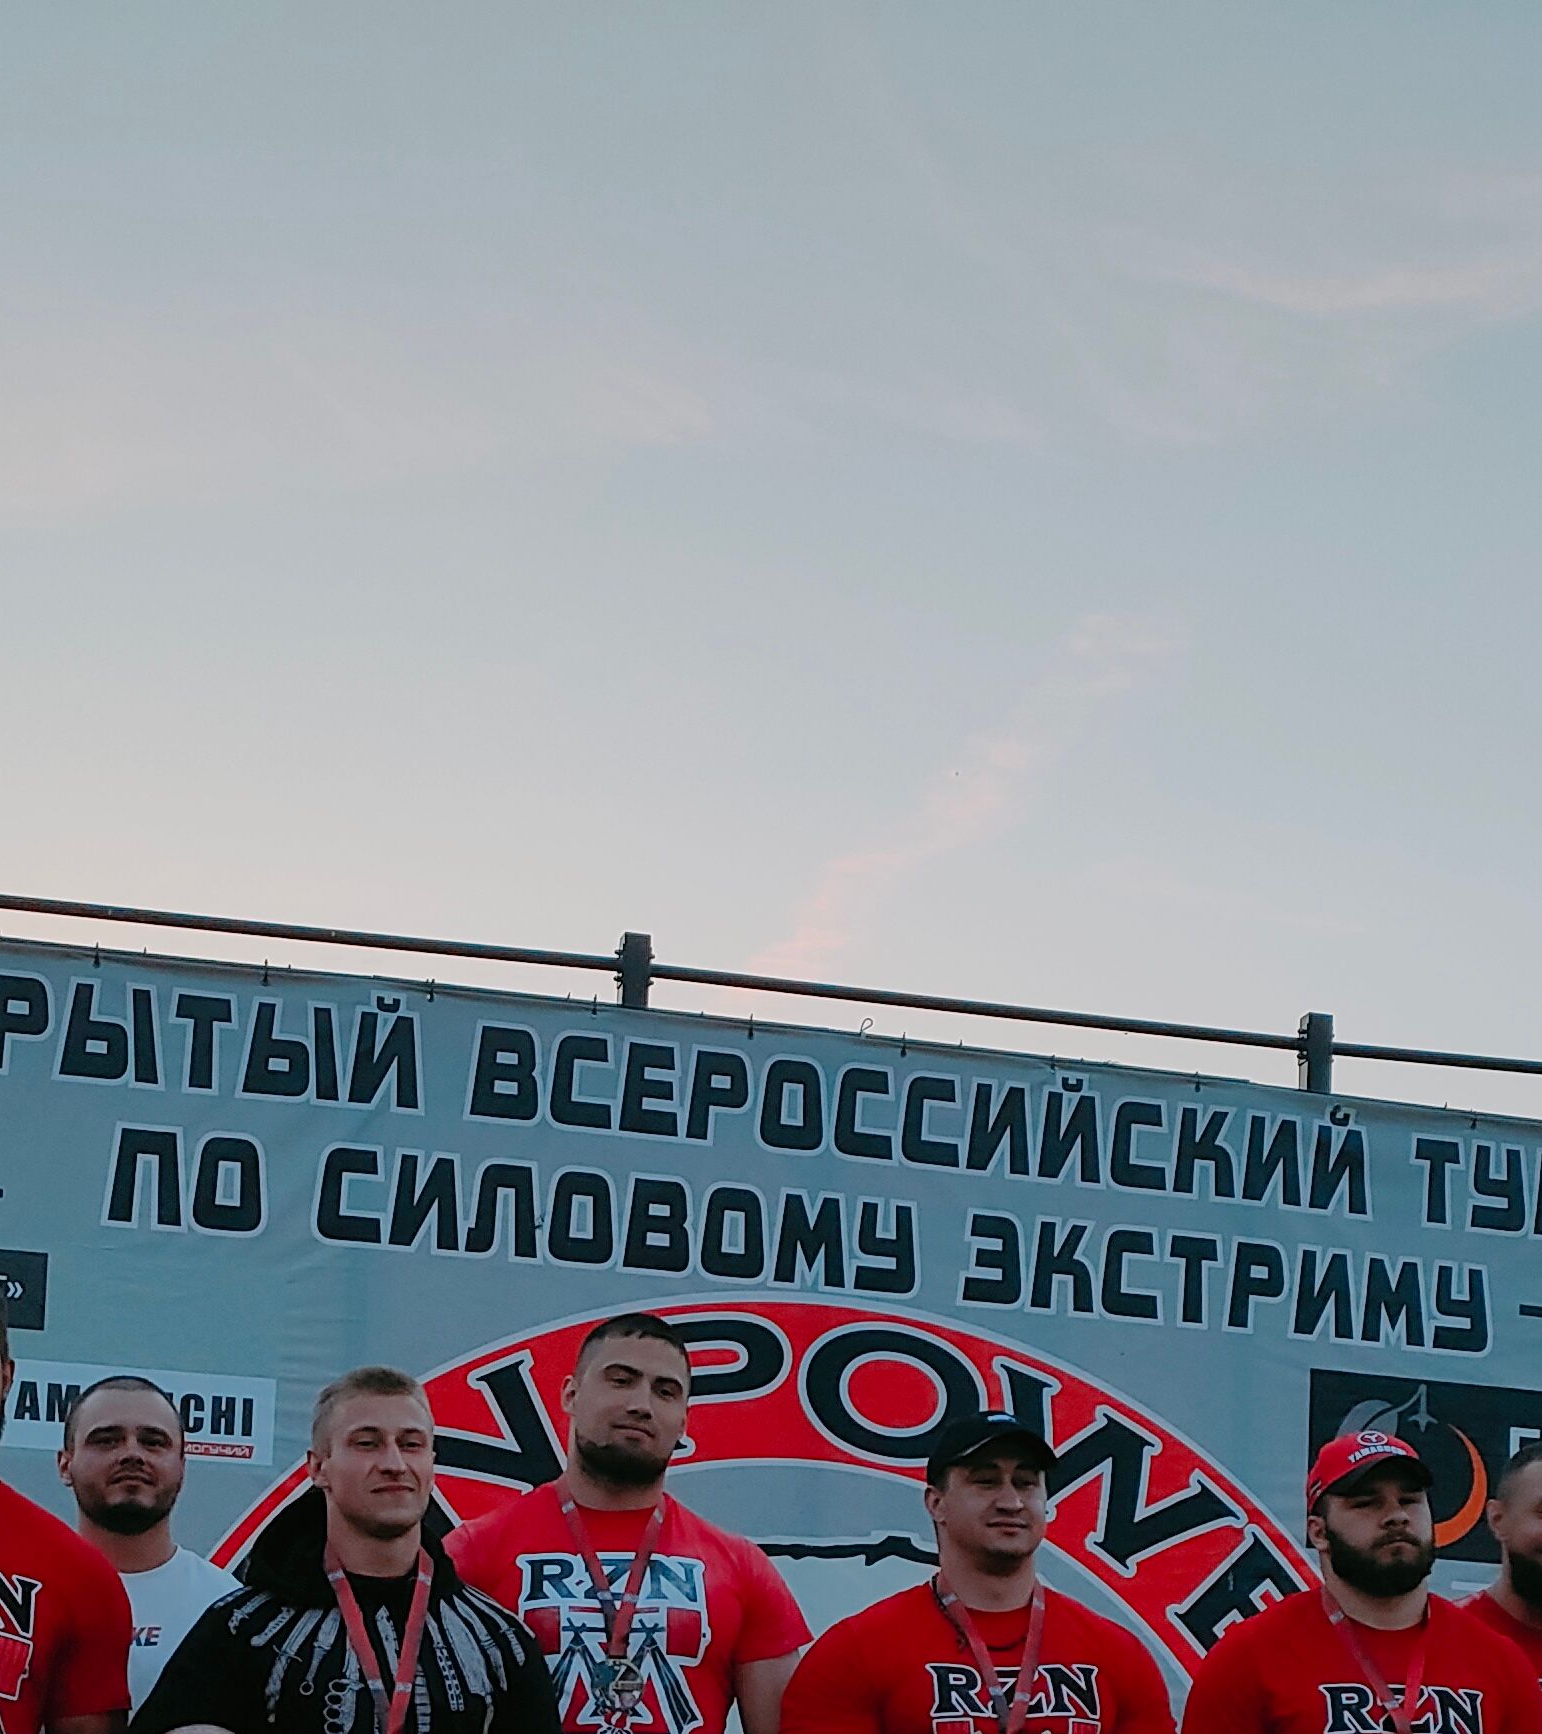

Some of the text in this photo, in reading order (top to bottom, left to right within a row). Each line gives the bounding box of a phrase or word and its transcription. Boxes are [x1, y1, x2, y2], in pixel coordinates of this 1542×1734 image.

[467, 1024, 1370, 1218] ВСЕРОССИЙСКИЙ
[107, 1126, 1491, 1355] ПО СИЛОВОМУ ЭКСТРИМУ
[525, 1557, 701, 1604] RZN
[924, 1663, 1101, 1718] RZN
